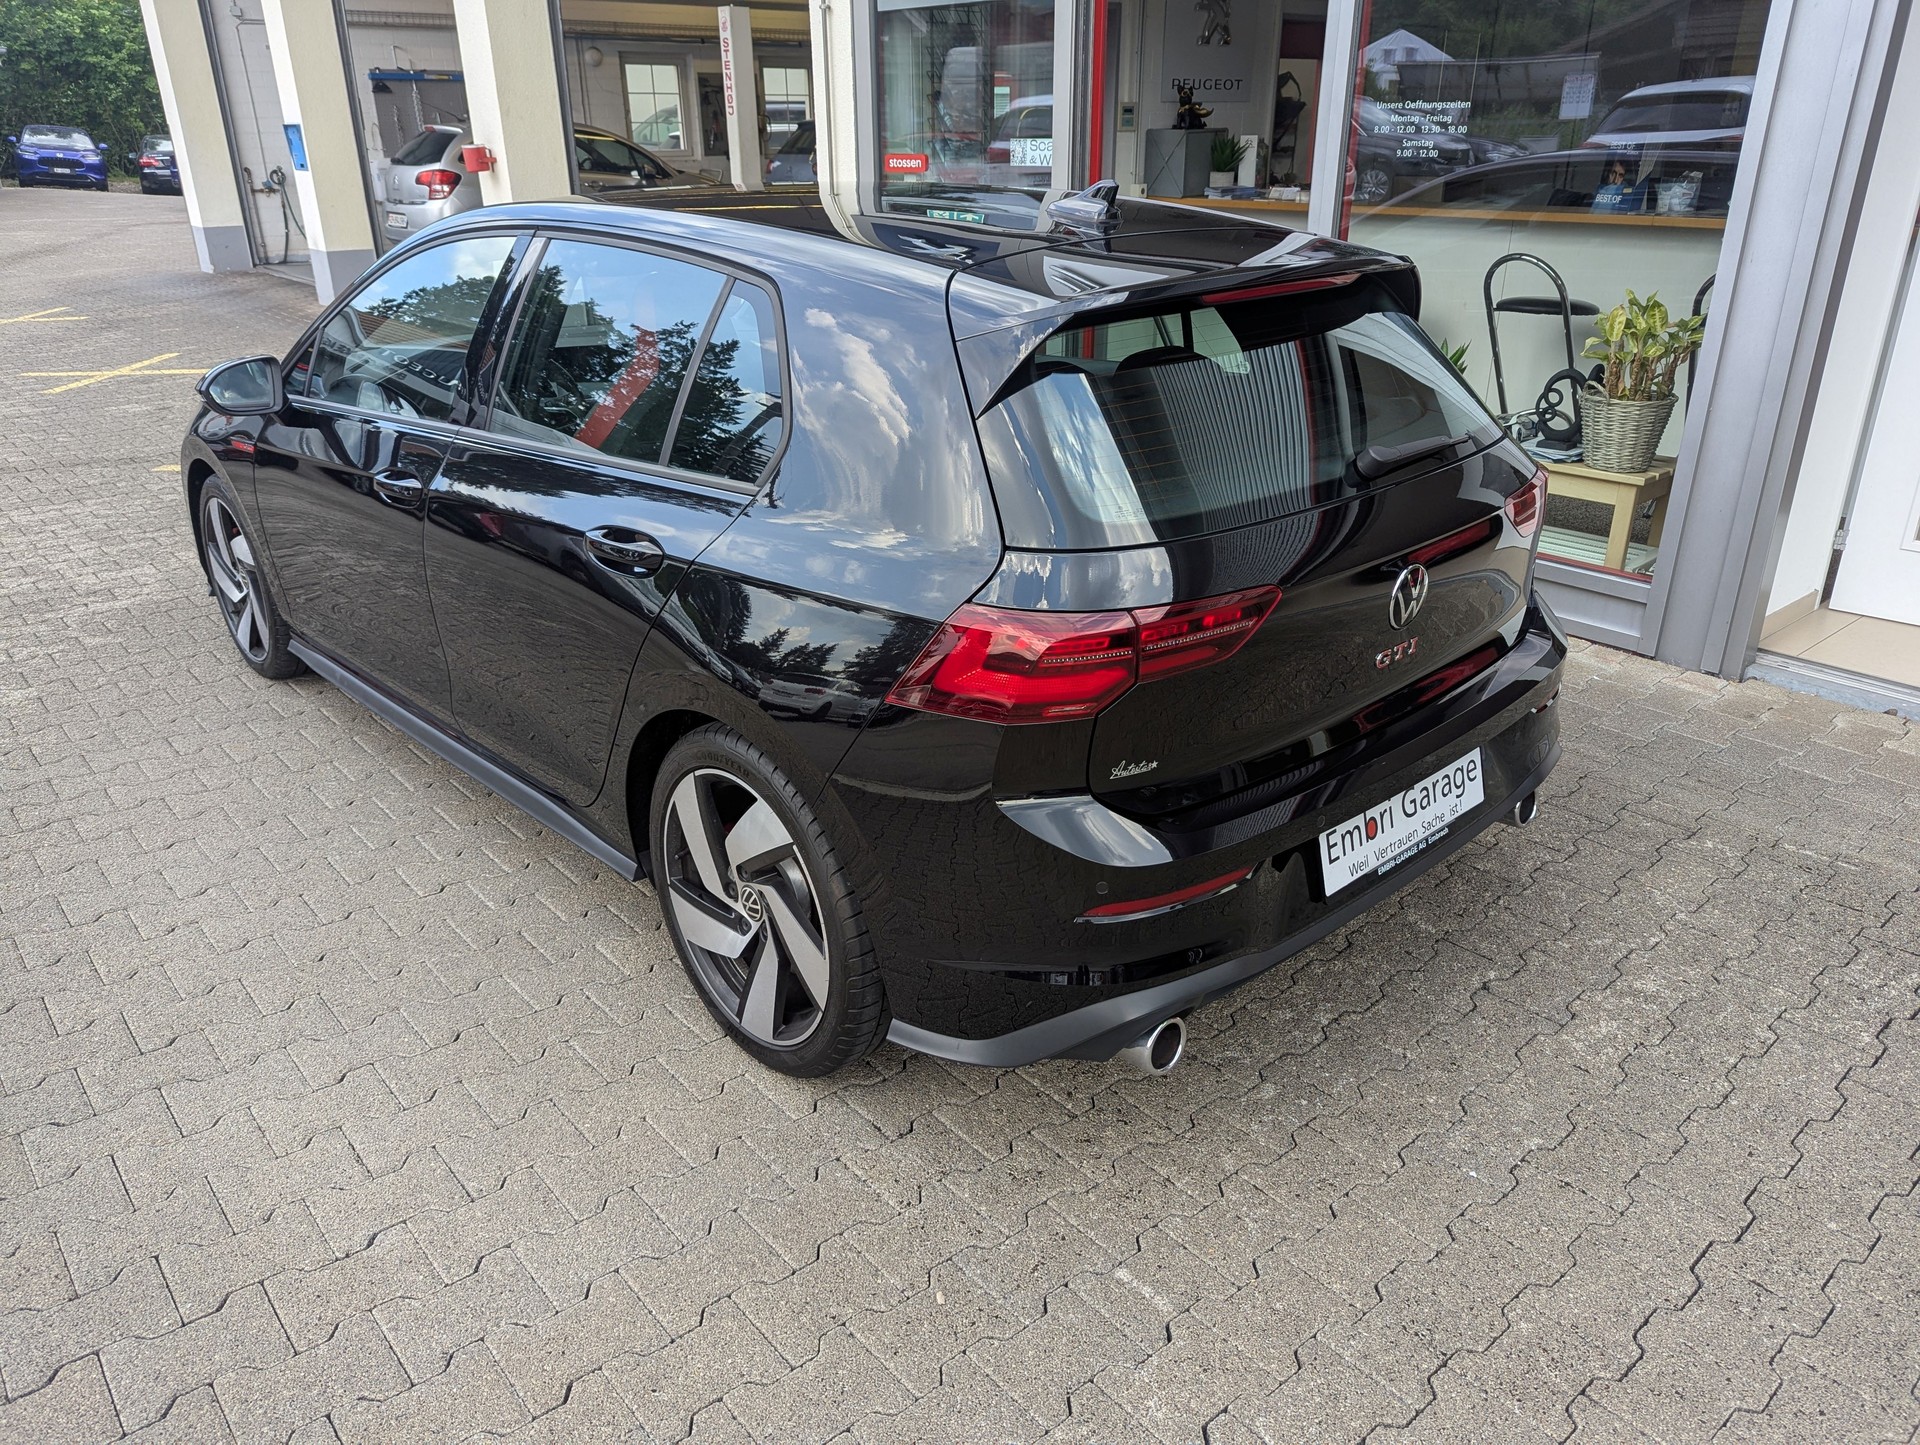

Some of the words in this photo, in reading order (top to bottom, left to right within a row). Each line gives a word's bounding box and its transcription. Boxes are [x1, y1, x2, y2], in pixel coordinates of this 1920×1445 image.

[1171, 78, 1243, 90] PEUGEOT
[1376, 101, 1403, 109] Unsere
[1404, 99, 1471, 110] Oeffnungszeiten
[1390, 114, 1419, 124] Montag
[1425, 114, 1452, 124] Freitag
[1402, 139, 1434, 149] Samstag
[1396, 149, 1412, 157] 9.00
[1419, 149, 1439, 158] 12.00
[889, 158, 922, 168] stossen
[1029, 155, 1037, 164] &
[1595, 193, 1612, 203] BEST
[1612, 195, 1623, 204] OF
[1376, 636, 1419, 669] GTI
[1325, 799, 1395, 866] Embri
[1401, 758, 1478, 818] Garage
[1348, 857, 1370, 878] Weil
[1373, 828, 1419, 862] Vertrauen
[1421, 810, 1446, 834] Sache
[1378, 845, 1419, 876] EMBRI-GARAGE
[1418, 839, 1427, 851] AG
